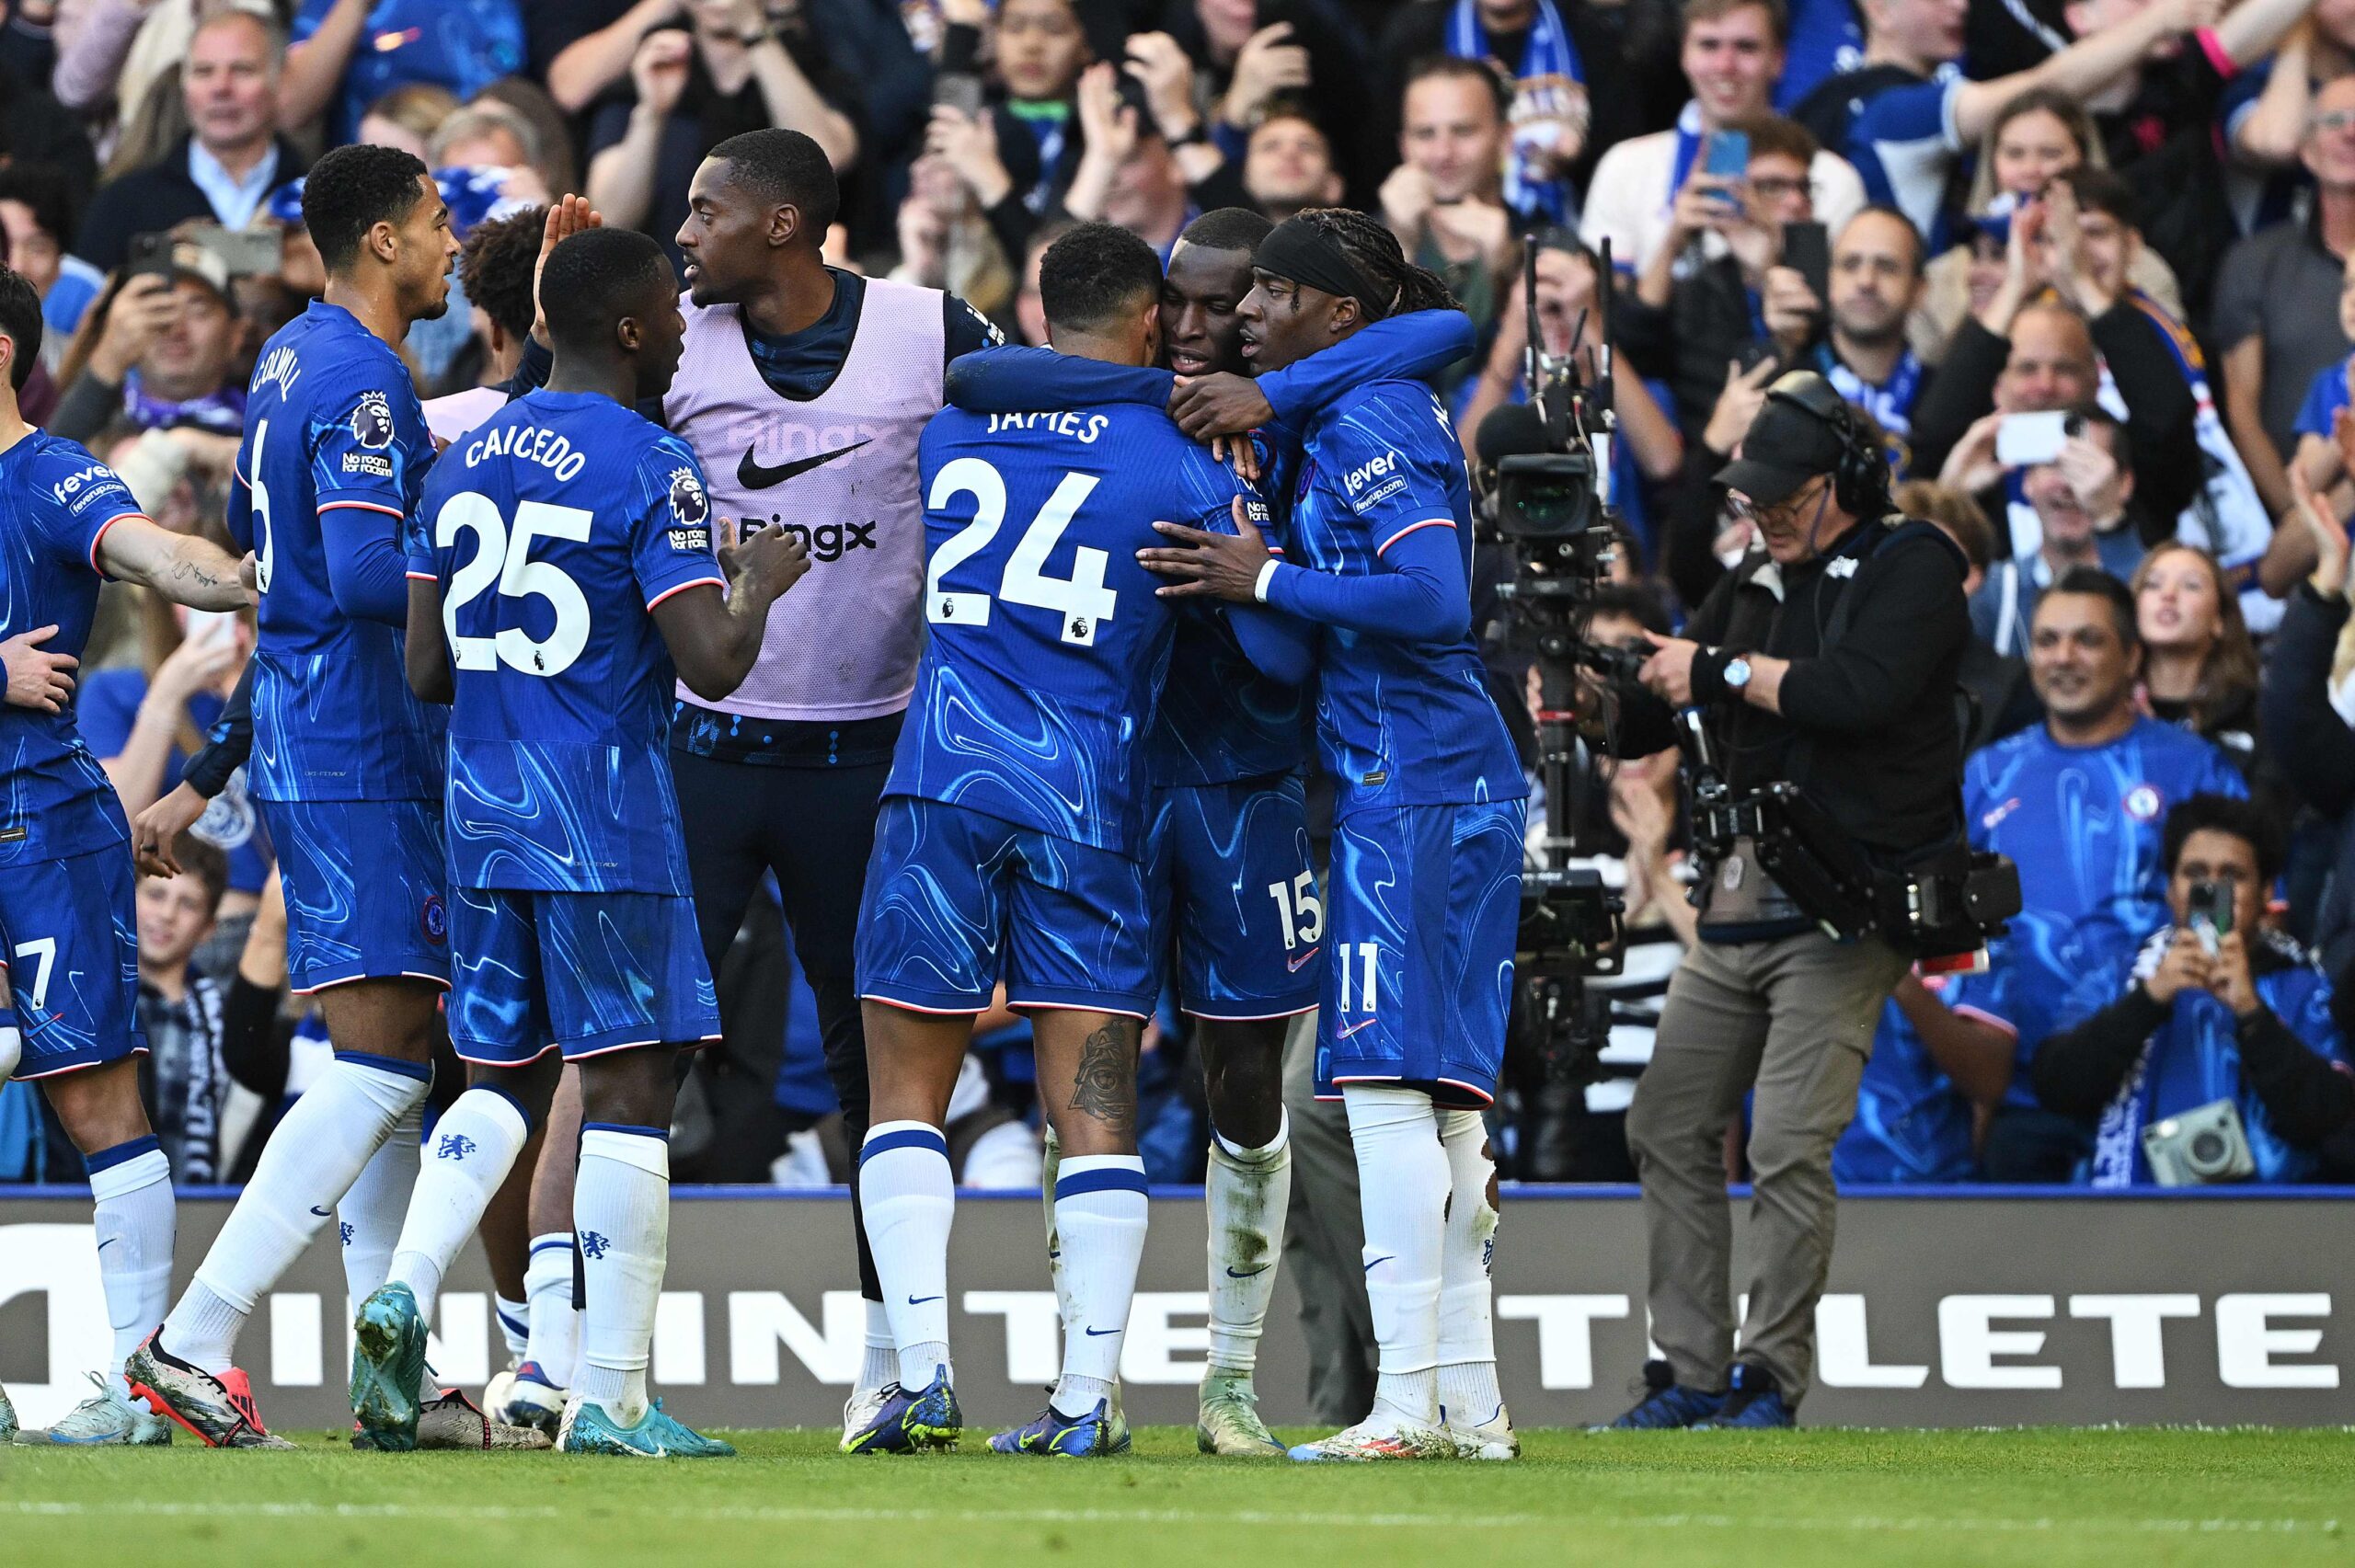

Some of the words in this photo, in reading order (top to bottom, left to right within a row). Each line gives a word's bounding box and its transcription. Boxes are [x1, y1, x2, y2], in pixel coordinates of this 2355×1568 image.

[252, 346, 301, 403] COLWILL
[342, 452, 360, 464] No
[465, 425, 586, 483] CAICEDO
[987, 411, 1109, 444] JAMES
[1344, 451, 1396, 497] fever
[740, 513, 877, 562] Bngx
[925, 458, 1118, 647] 24
[436, 491, 593, 677] 25
[1269, 869, 1323, 950] 15
[15, 937, 56, 1012] 7
[1339, 943, 1378, 1012] 11
[1497, 1293, 2340, 1389] TLETE
